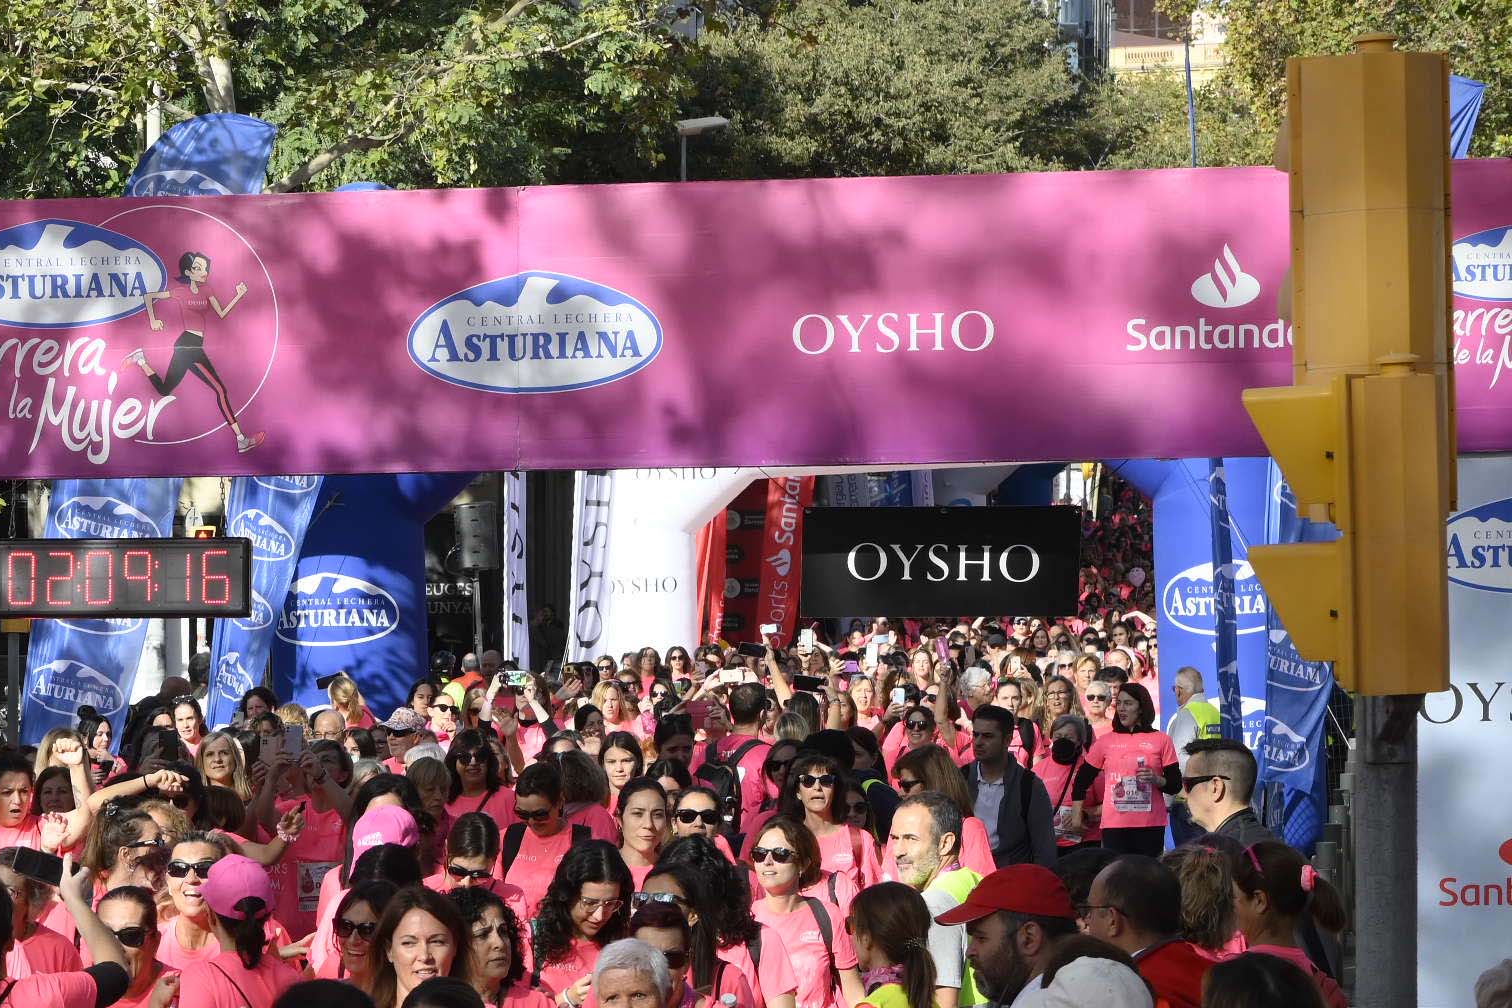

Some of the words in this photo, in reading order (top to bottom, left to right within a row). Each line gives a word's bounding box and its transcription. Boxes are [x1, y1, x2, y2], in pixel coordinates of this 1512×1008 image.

[71, 256, 144, 267] LECHERA
[467, 313, 546, 327] CENTRAL
[553, 311, 635, 326] LECHERA
[792, 310, 996, 355] OYSHO
[427, 318, 643, 365] ASTURIANA
[8, 379, 34, 420] la
[28, 371, 177, 465] Mujer
[8, 551, 231, 605] 02:09:16
[846, 542, 1041, 583] OYSHO
[277, 607, 390, 631] ASTURIANA
